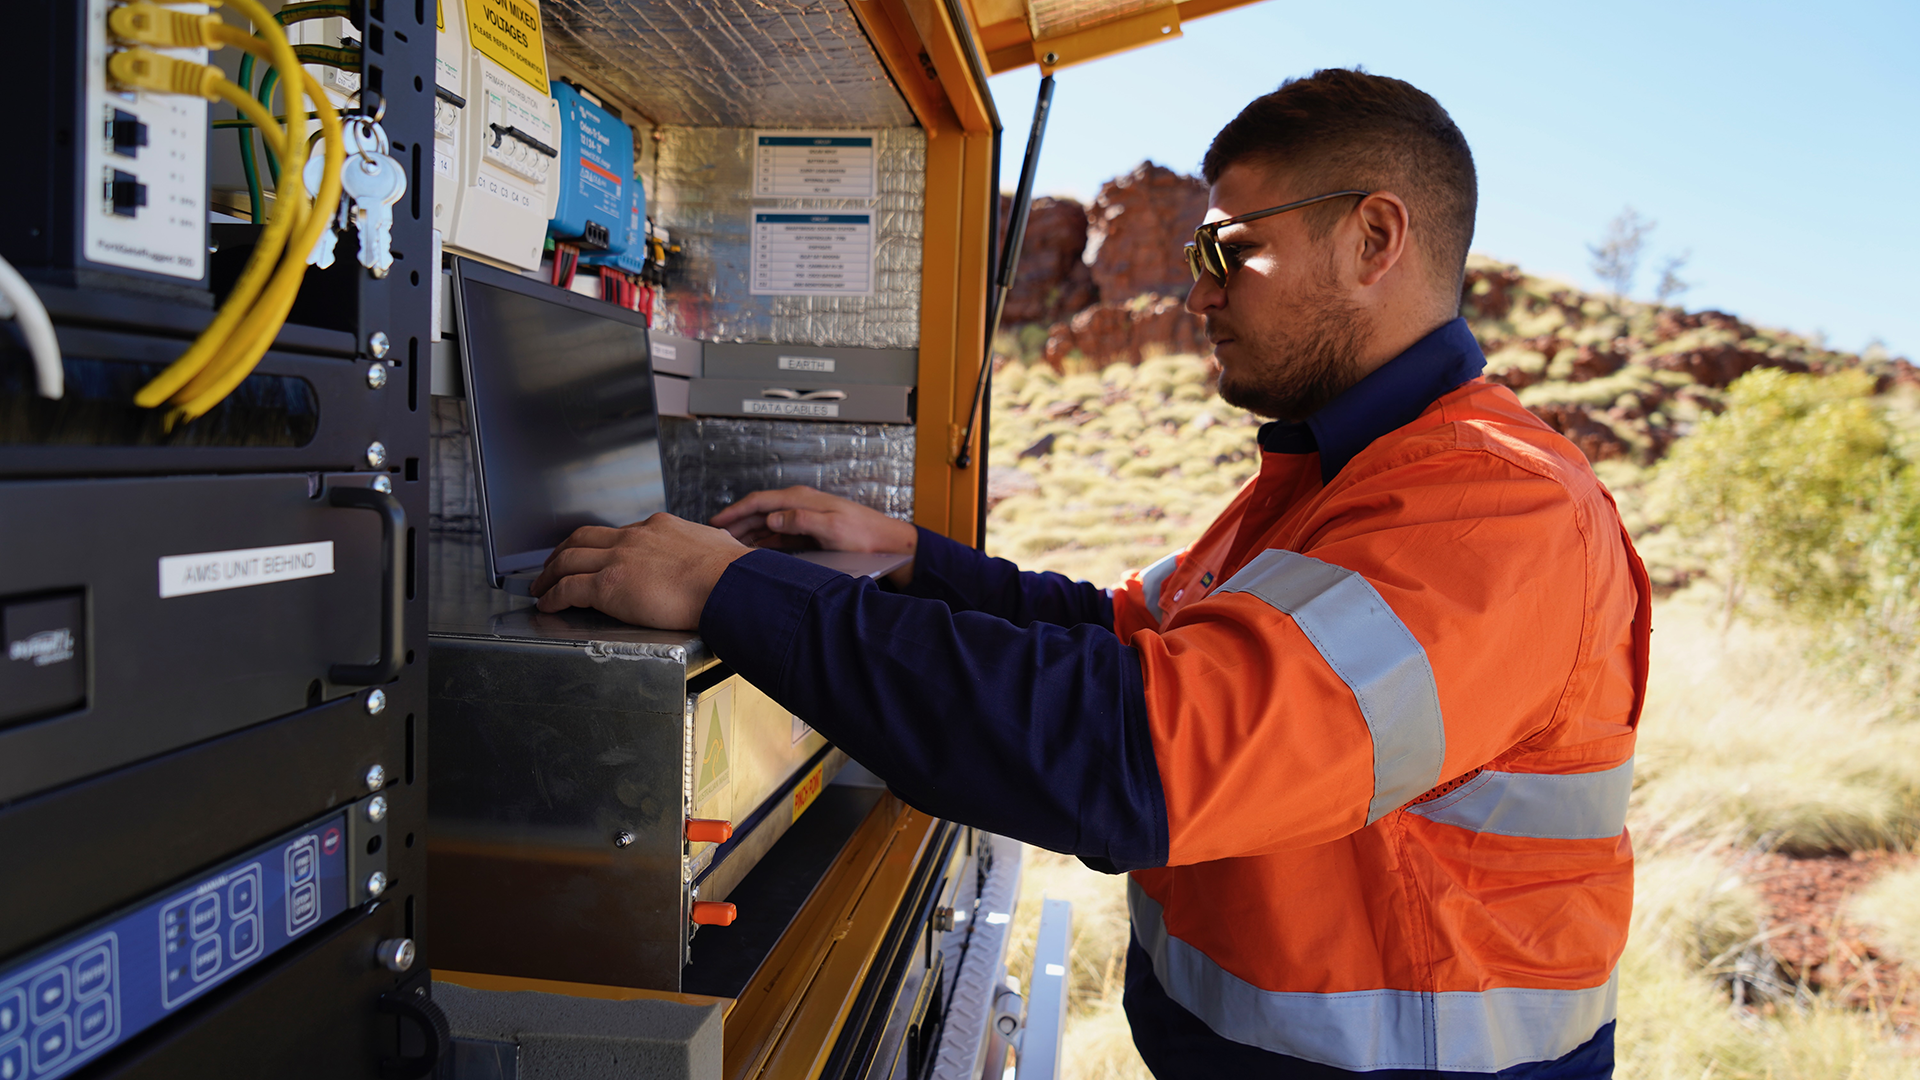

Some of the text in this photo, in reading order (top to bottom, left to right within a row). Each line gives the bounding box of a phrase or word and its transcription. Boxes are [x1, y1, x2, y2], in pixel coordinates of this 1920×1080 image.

[483, 4, 529, 48] VOLTAGES
[509, 0, 537, 31] MIXED
[473, 22, 543, 76] PLEASE REFER TO SCHEMATICS
[485, 70, 507, 91] PRIMARY
[507, 84, 538, 110] DISTRIBUTION
[440, 159, 448, 171] 14
[478, 176, 530, 207] C1 C2 C3 C4 C5
[788, 359, 825, 371] EARTH
[752, 402, 829, 416] DATA CABLES
[222, 558, 263, 581] UNIT
[263, 552, 317, 576] BEHIND
[794, 767, 823, 815] PINCH POINT
